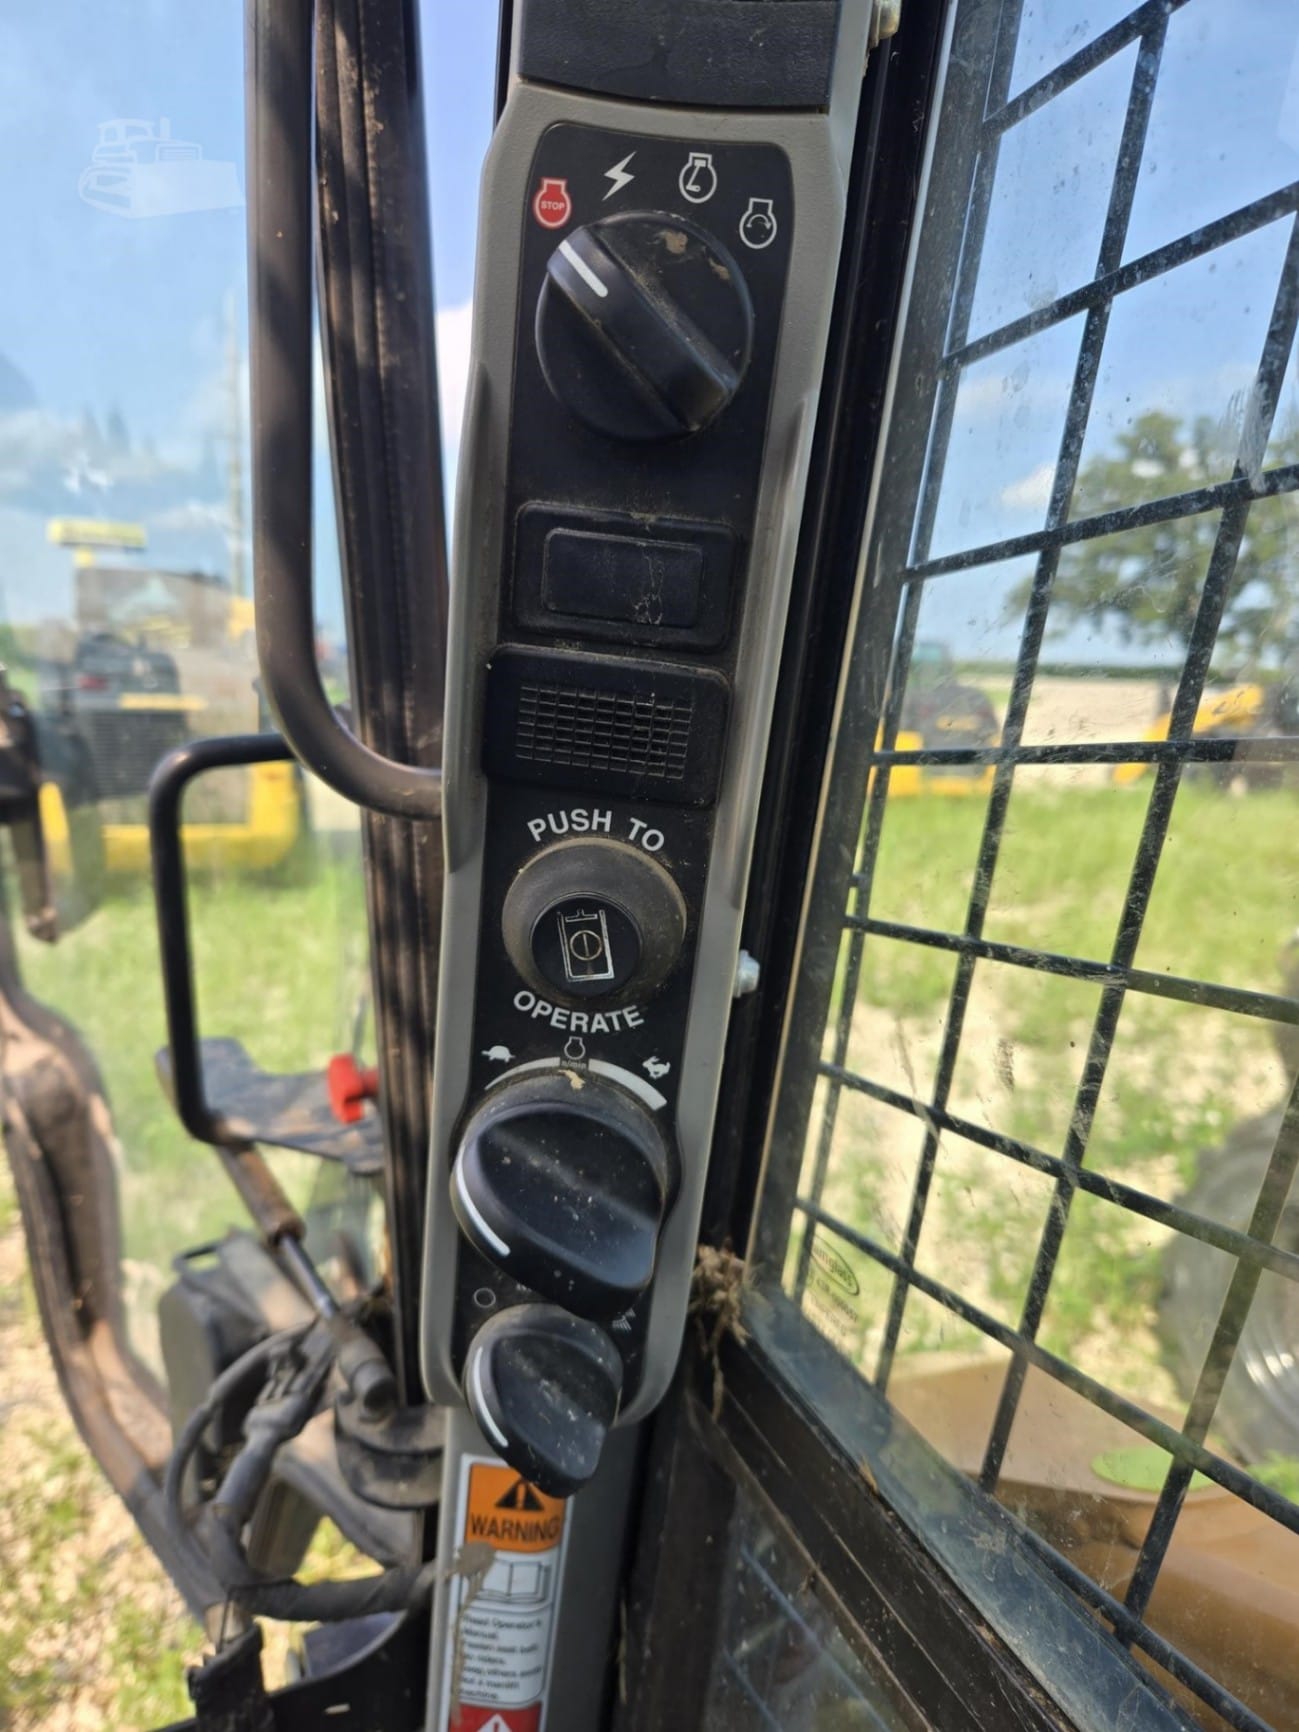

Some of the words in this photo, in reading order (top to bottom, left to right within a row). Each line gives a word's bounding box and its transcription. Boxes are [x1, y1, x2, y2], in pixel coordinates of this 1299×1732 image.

[541, 200, 565, 210] STOP
[527, 808, 613, 842] PUSH
[628, 818, 665, 852] TO
[513, 990, 644, 1033] OPERATE
[471, 1513, 561, 1542] WARNING
